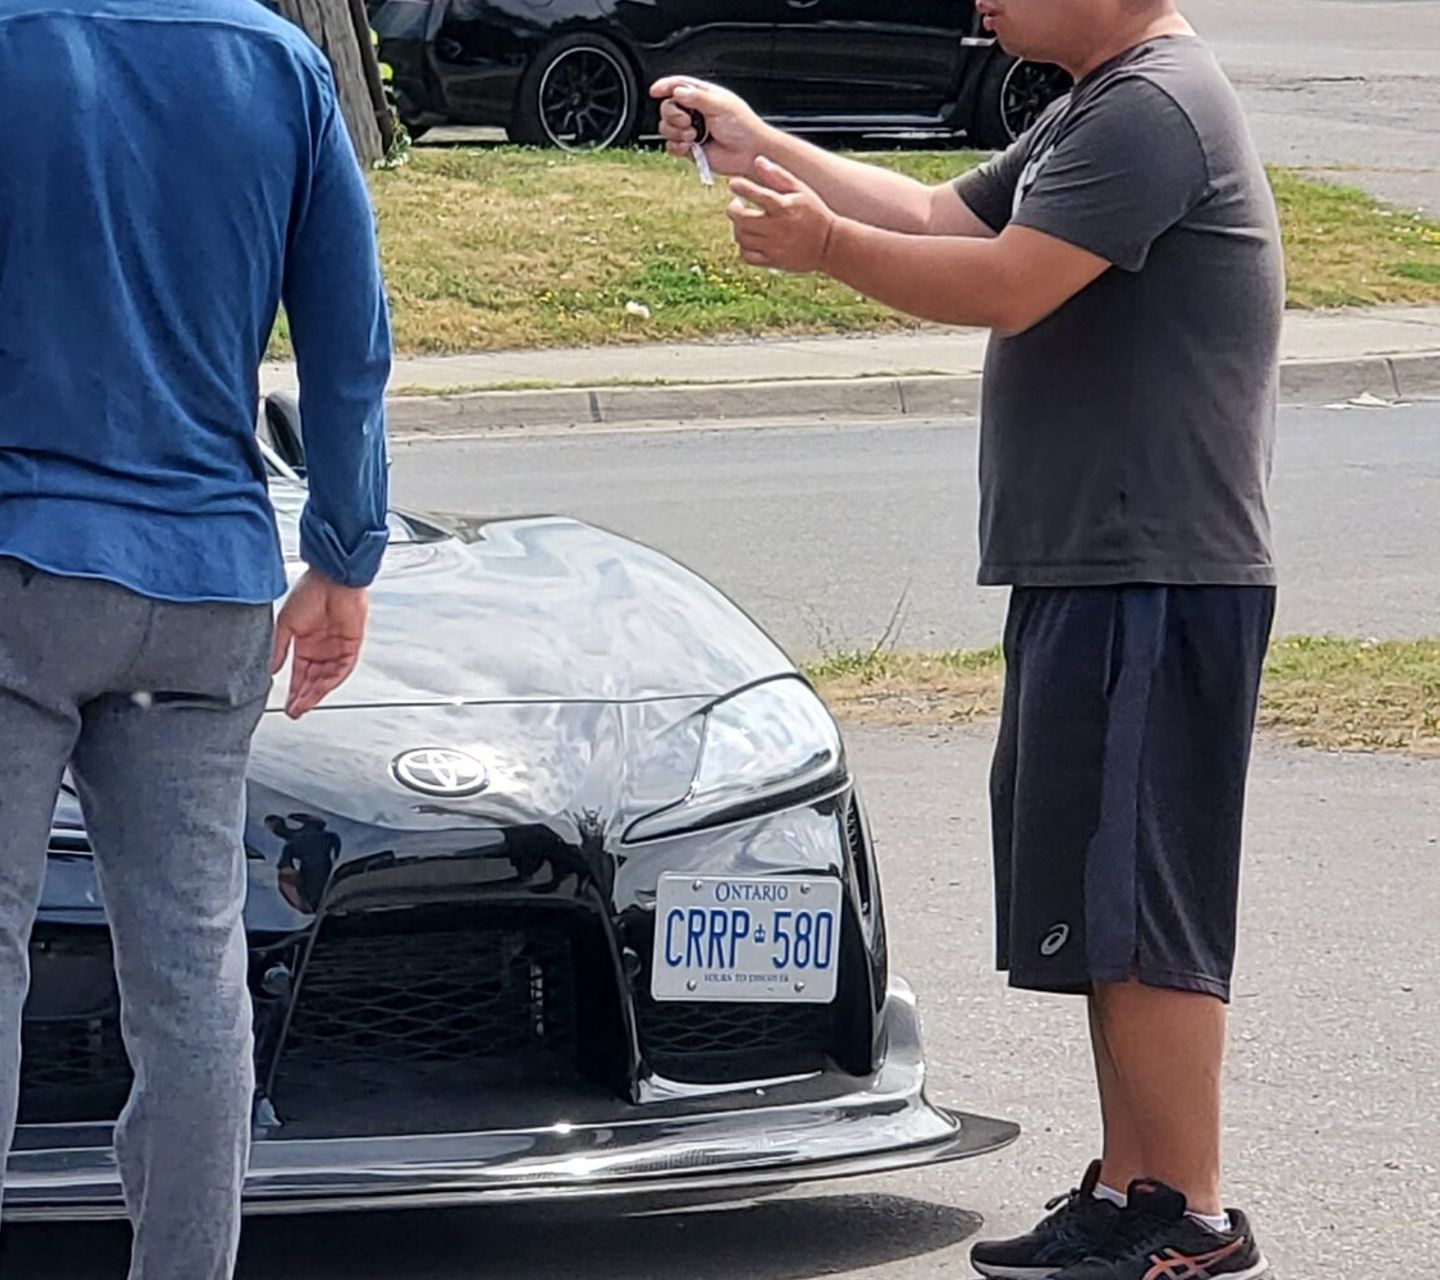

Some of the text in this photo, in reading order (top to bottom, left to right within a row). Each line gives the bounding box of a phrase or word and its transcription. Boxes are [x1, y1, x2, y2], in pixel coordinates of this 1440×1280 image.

[715, 881, 789, 903] ONTARIO
[665, 908, 833, 969] CRRP 580
